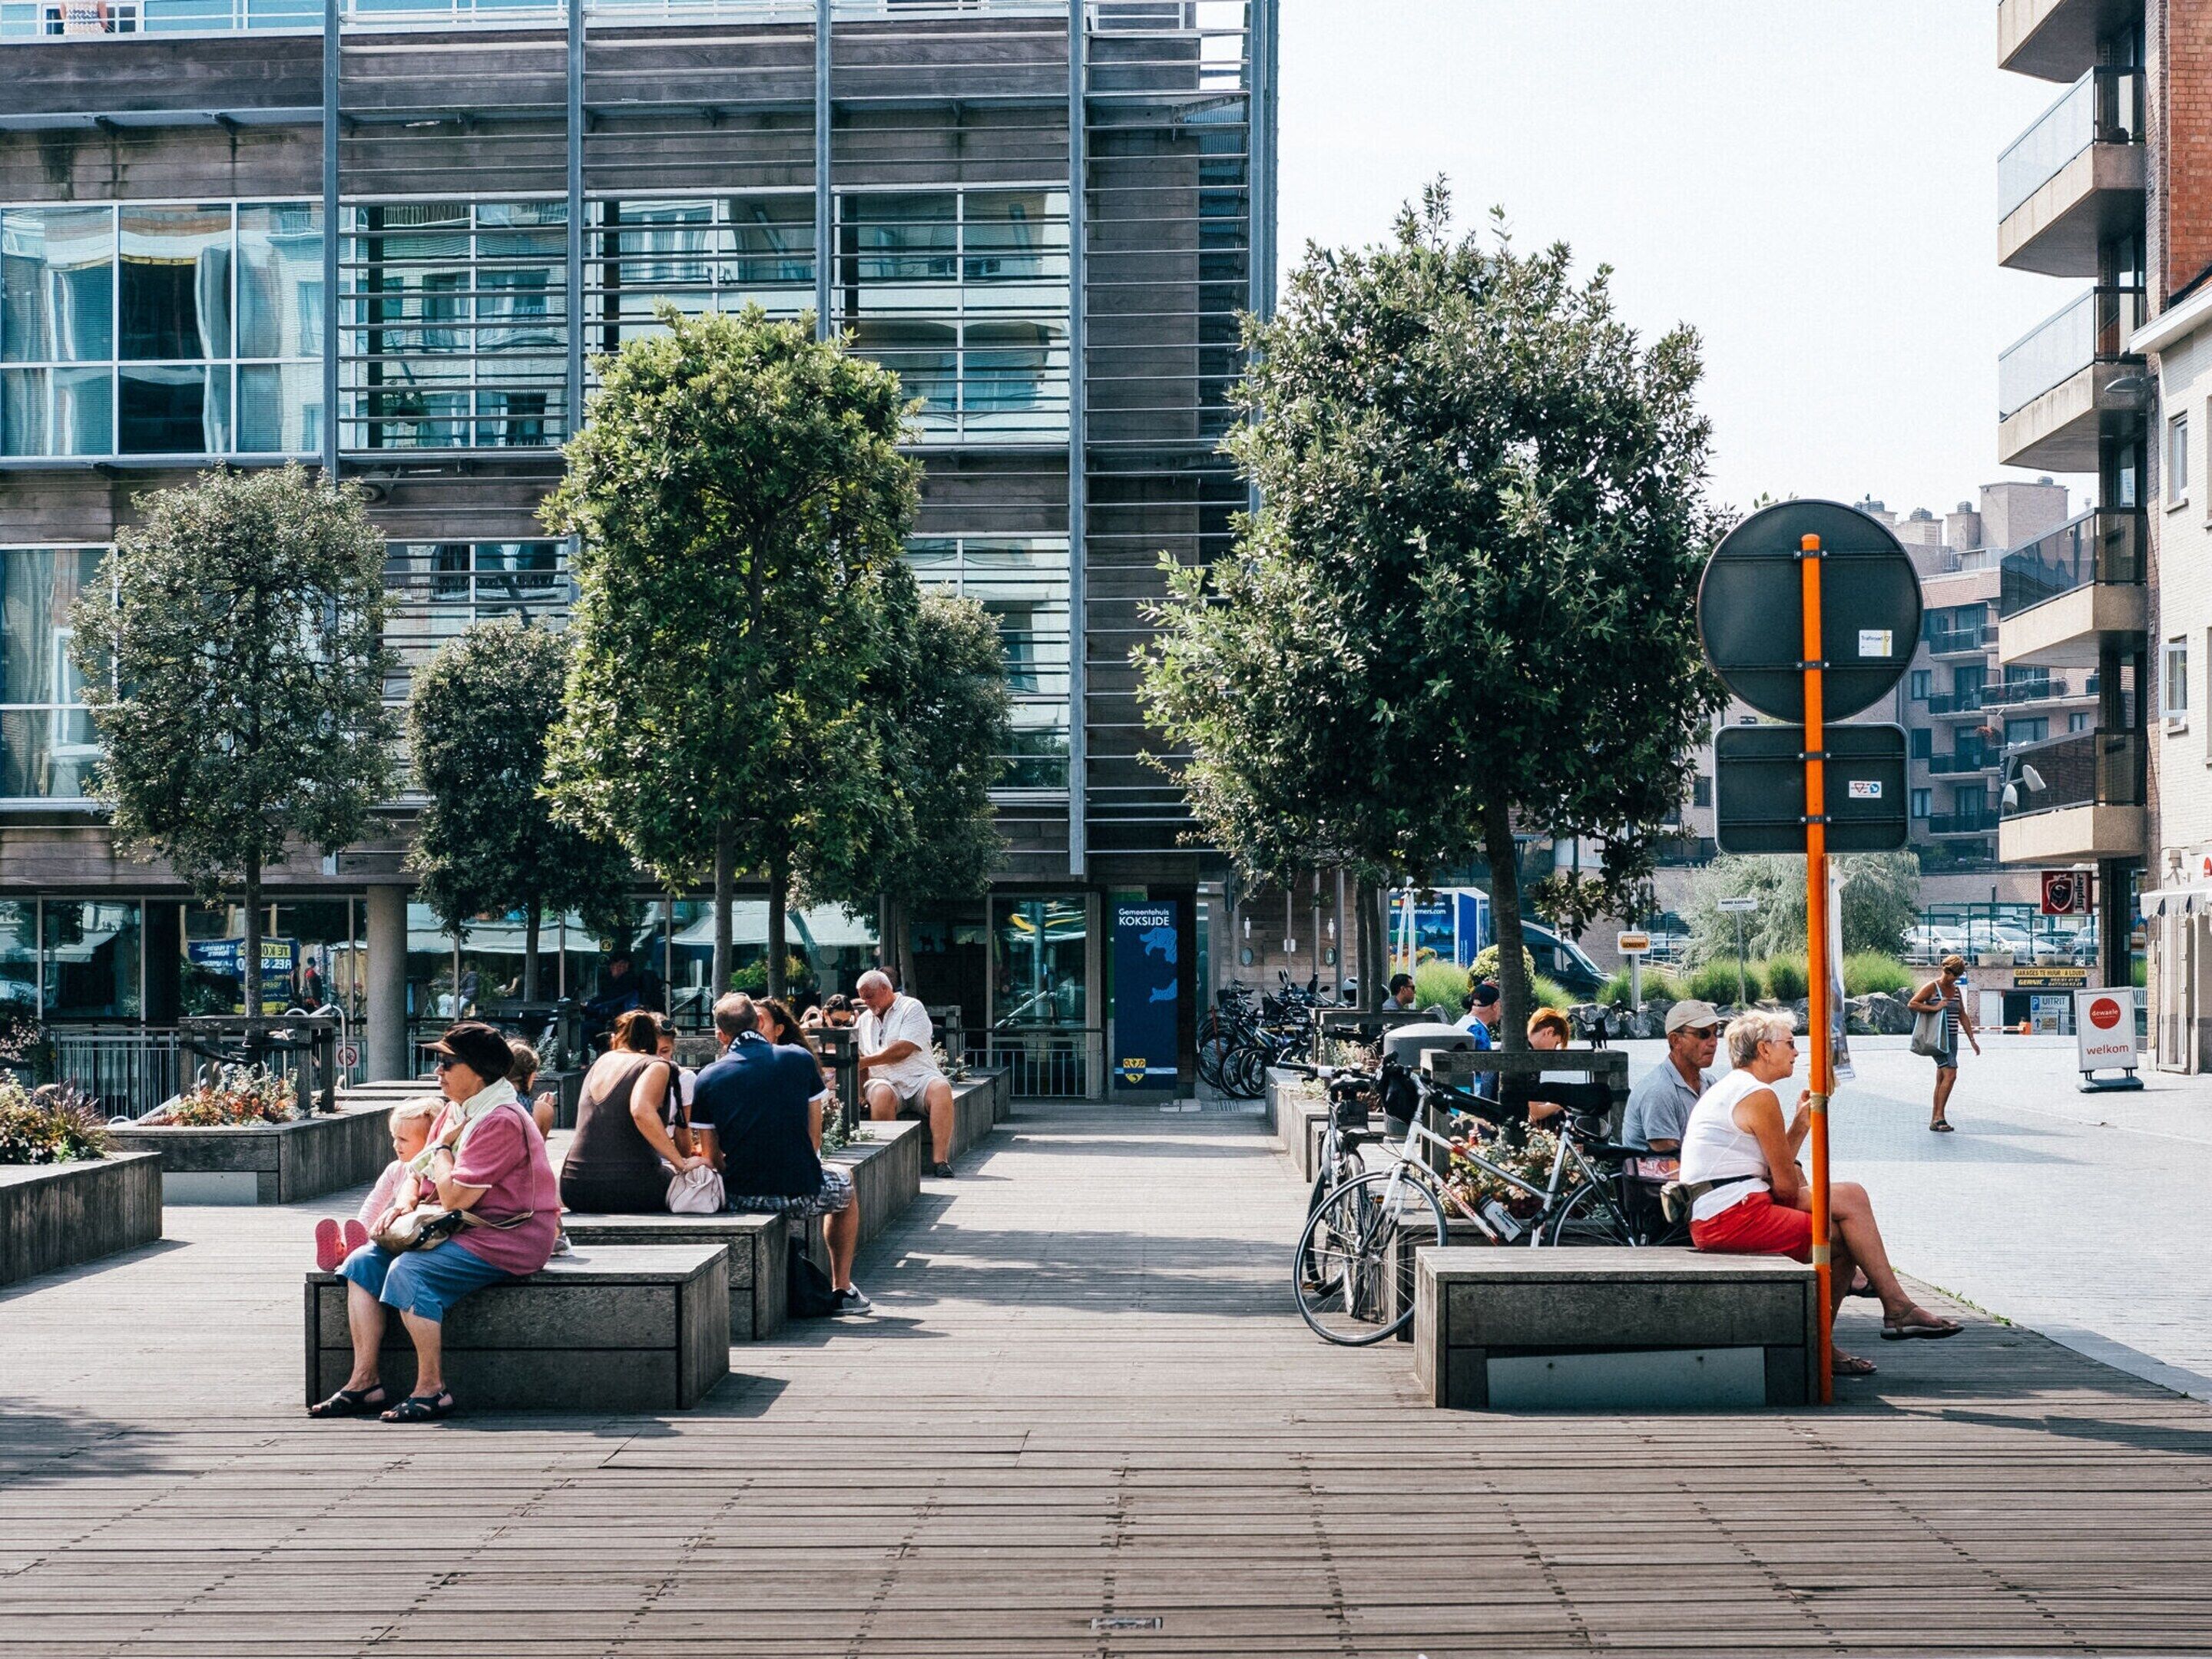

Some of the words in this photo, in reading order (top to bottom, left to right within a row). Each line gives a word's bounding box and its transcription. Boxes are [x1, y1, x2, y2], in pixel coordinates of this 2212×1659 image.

[1118, 916, 1170, 926] KOKSIJDE
[2042, 997, 2066, 1005] UITRIT
[2091, 1008, 2118, 1017] dewaele
[2086, 1045, 2129, 1055] welkom
